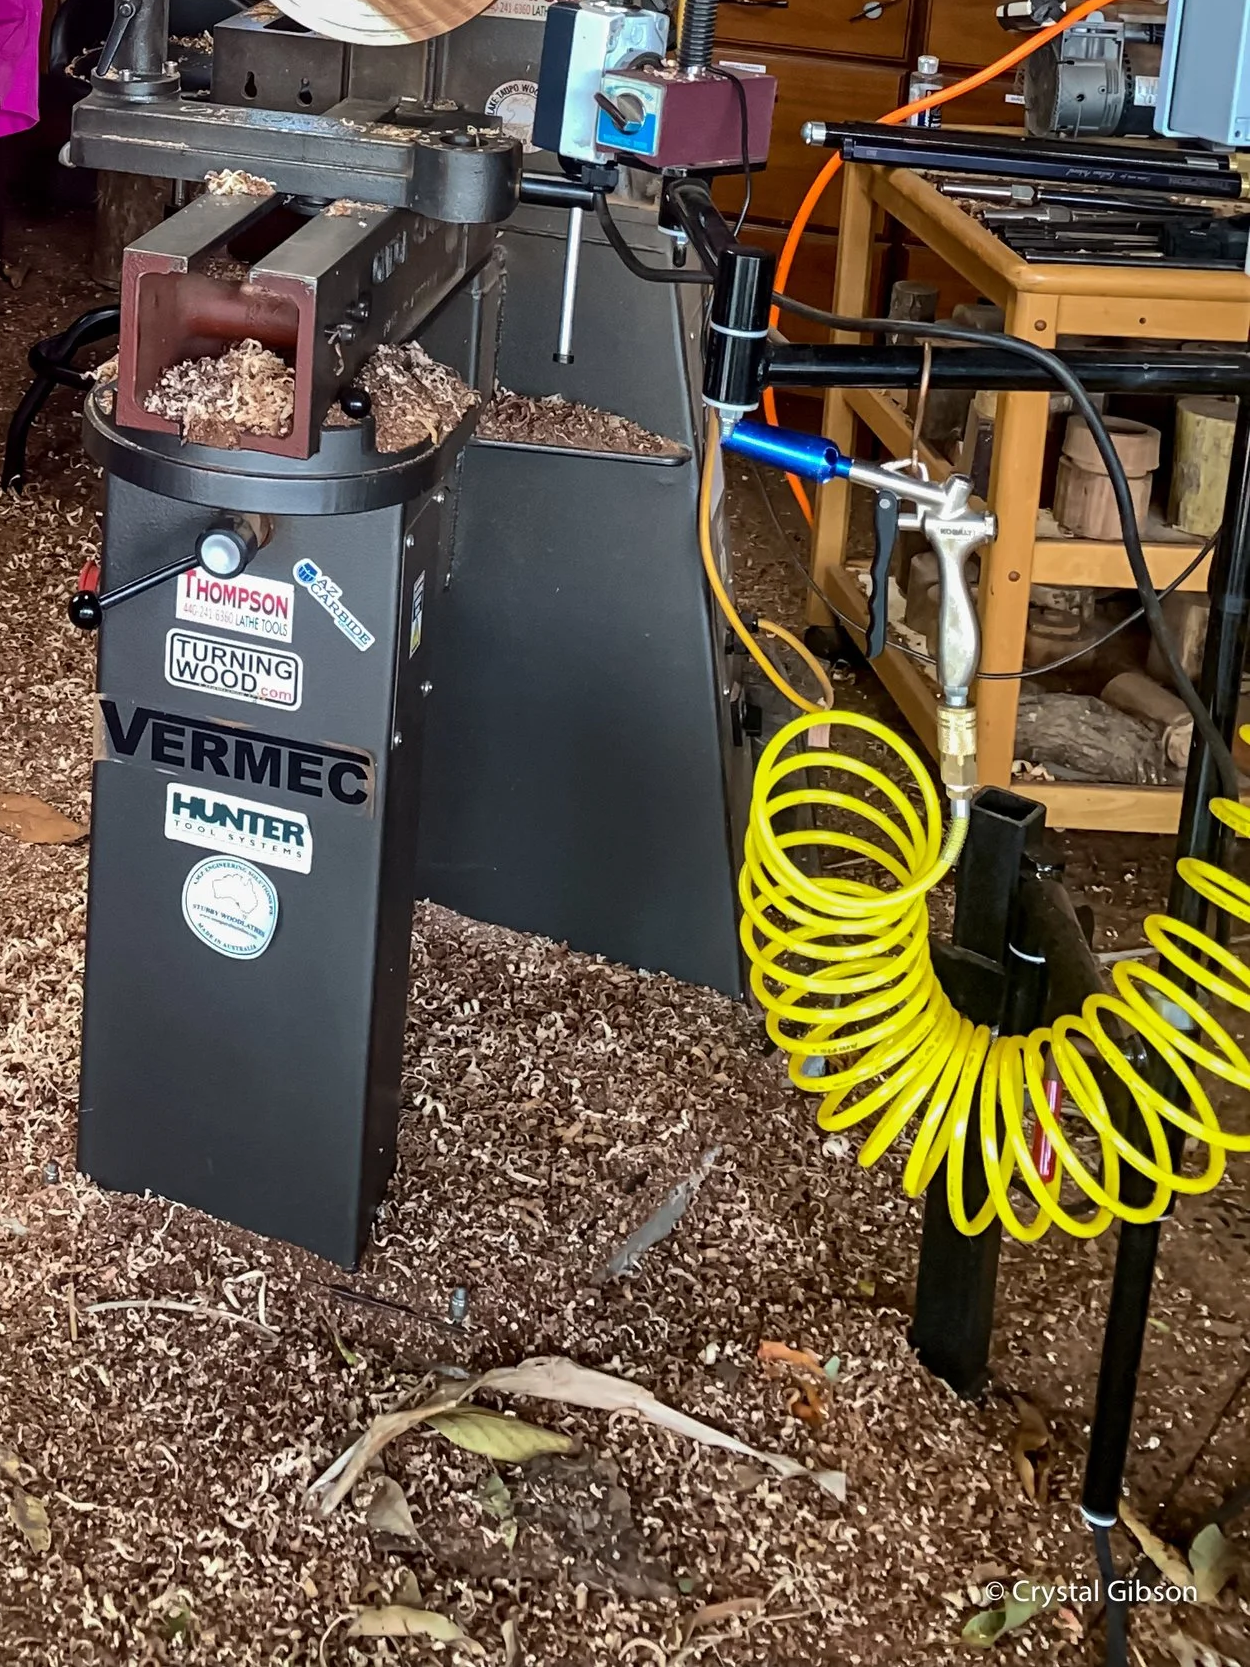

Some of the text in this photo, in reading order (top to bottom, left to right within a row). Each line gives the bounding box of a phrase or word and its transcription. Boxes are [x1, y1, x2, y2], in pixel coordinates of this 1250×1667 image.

[487, 97, 499, 115] LAKE
[496, 84, 519, 98] TAUPO
[185, 569, 288, 620] THOMPSON
[318, 578, 339, 597] AZ
[236, 615, 259, 630] LATHE
[262, 619, 287, 636] TOOLS
[310, 583, 371, 645] CARBIDE
[177, 638, 292, 680] TURNING
[177, 658, 257, 693] WOOD
[99, 700, 370, 806] VERMEC
[173, 792, 304, 847] HUNTER
[174, 820, 301, 858] TOOL SYSTEMS
[205, 862, 247, 873] ENGINEERING
[192, 903, 218, 917] STUBBY
[198, 922, 214, 939] MADE
[223, 942, 257, 951] AUSTRALIA
